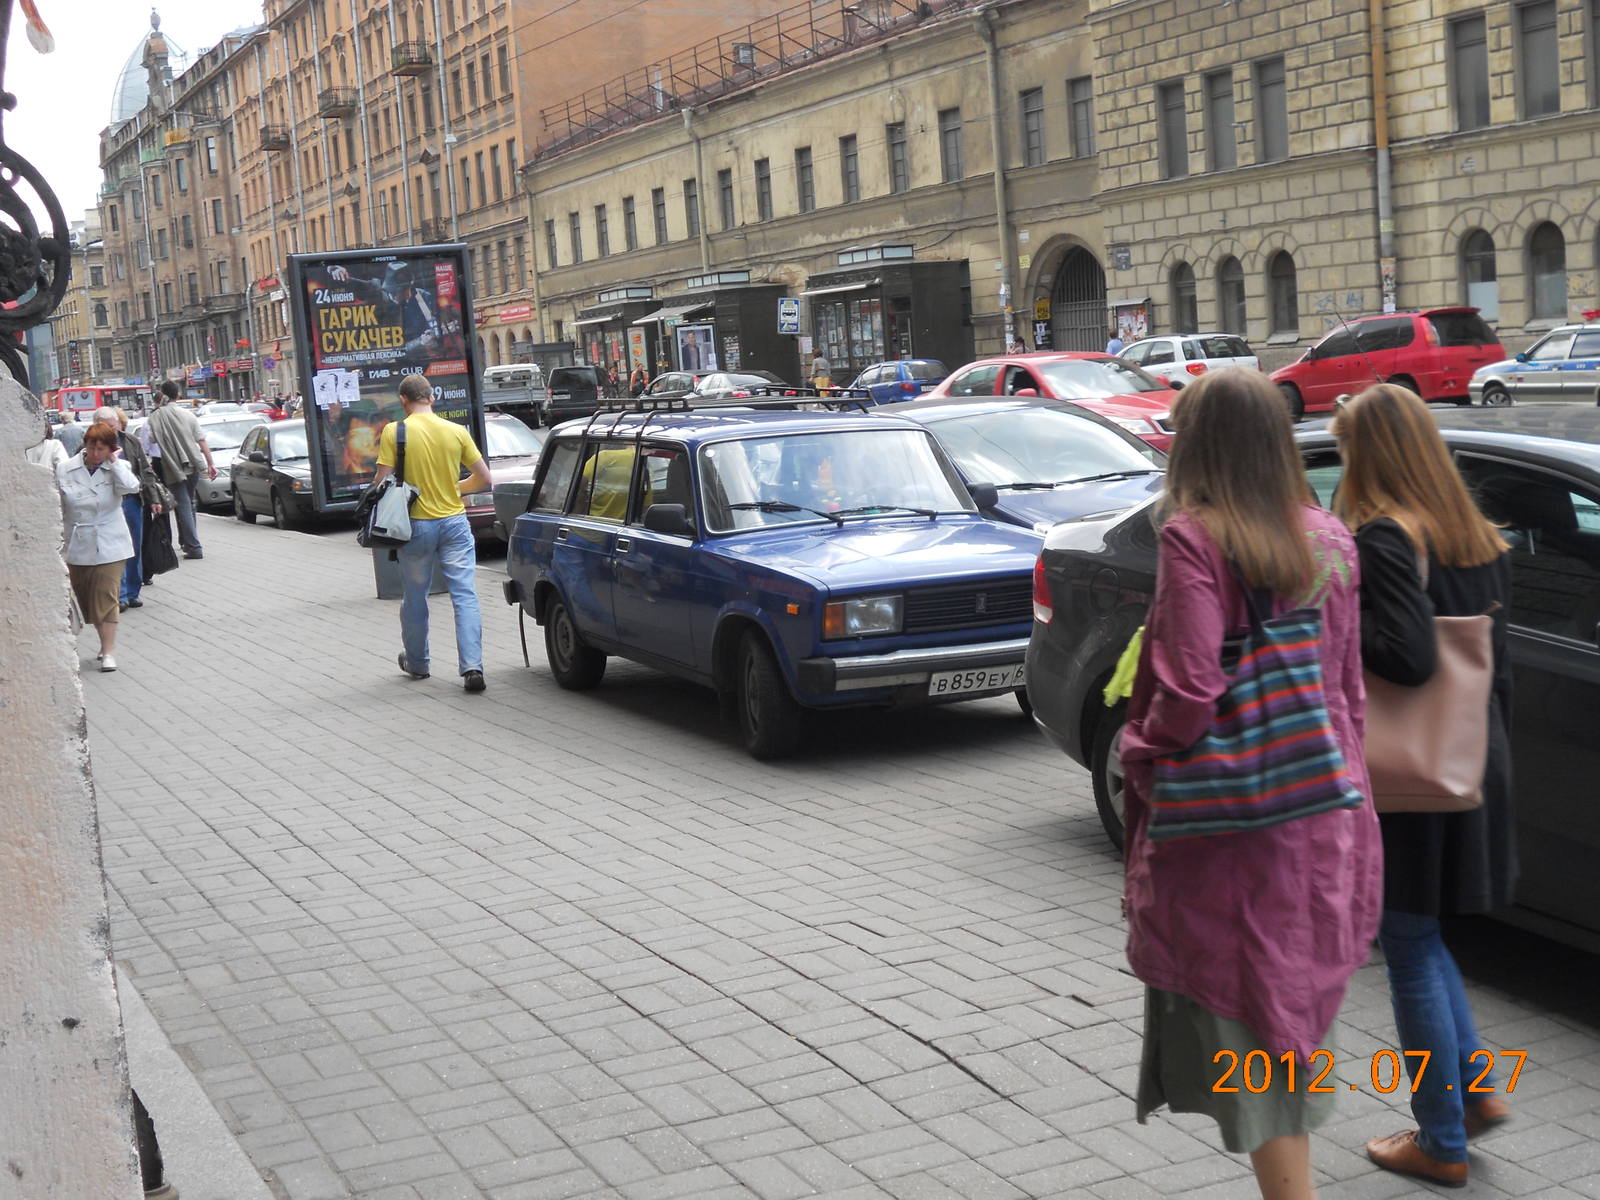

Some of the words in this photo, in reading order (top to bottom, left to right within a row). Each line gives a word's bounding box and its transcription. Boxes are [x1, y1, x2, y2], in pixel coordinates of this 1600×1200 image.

[315, 289, 330, 304] 24
[331, 292, 354, 303] ИЮНЯ
[319, 304, 379, 330] ГАРИК
[321, 326, 405, 353] СУКАЧЕВ
[400, 366, 424, 376] CLUB
[443, 388, 467, 400] ИЮНЯ
